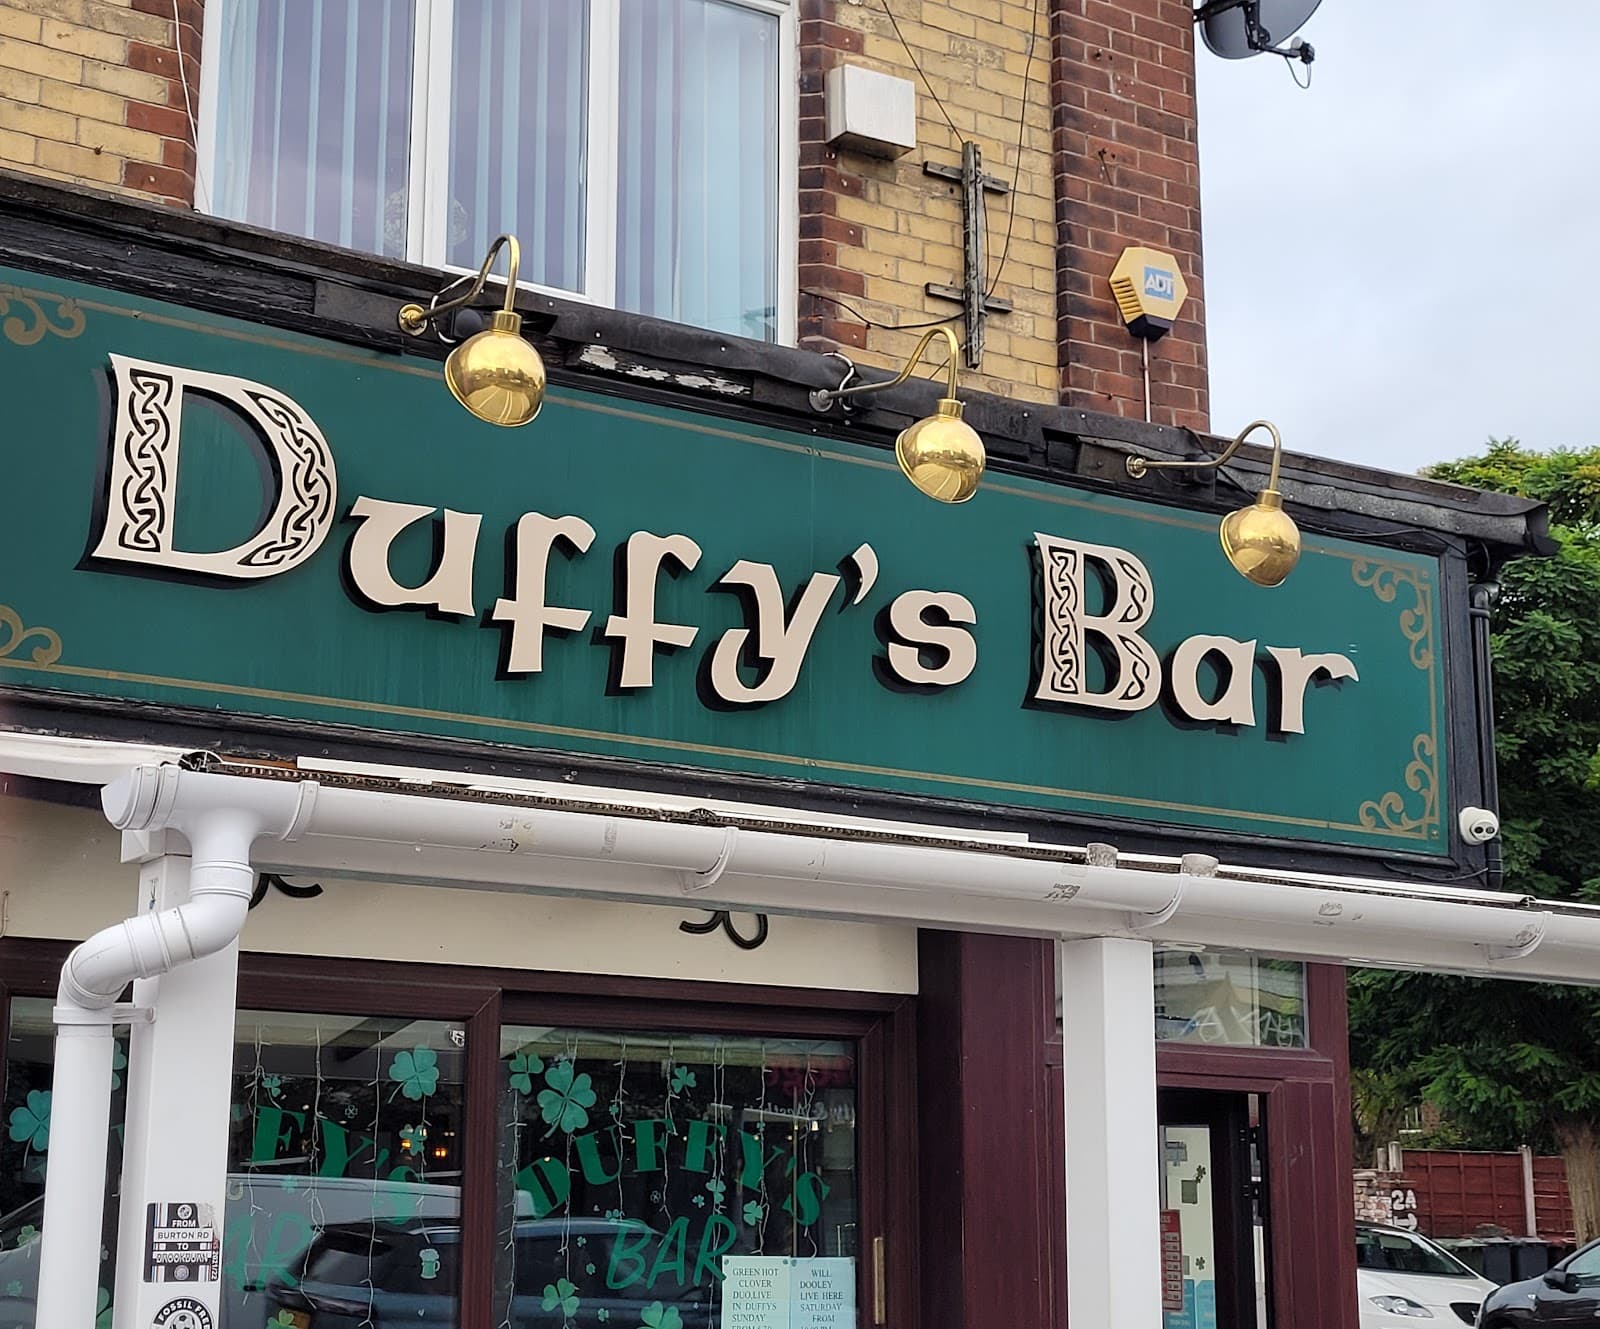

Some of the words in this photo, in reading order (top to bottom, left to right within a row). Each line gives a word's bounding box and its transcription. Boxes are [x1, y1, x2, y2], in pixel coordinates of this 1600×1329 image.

[1145, 273, 1173, 294] ADT
[92, 353, 977, 704] Duffy's
[1033, 531, 1359, 735] Bar
[514, 1119, 830, 1226] DUFFY'S
[1391, 1189, 1417, 1210] 2A
[172, 1220, 196, 1228] FROM
[157, 1231, 194, 1239] BURTON
[197, 1231, 209, 1239] RD
[177, 1242, 189, 1250] TO
[606, 1215, 737, 1290] BAR
[732, 1268, 761, 1276] GREEN
[762, 1268, 779, 1276] HOT
[811, 1269, 832, 1278] WILL
[739, 1280, 772, 1288] CLOVER
[800, 1280, 833, 1289] DOOLEY
[800, 1292, 819, 1300] LIVE
[822, 1292, 844, 1300] HERE
[157, 1300, 193, 1321] FOSSIL
[800, 1304, 842, 1312] SATURDAY
[732, 1314, 766, 1322] SUNDAY
[812, 1315, 835, 1323] FROM
